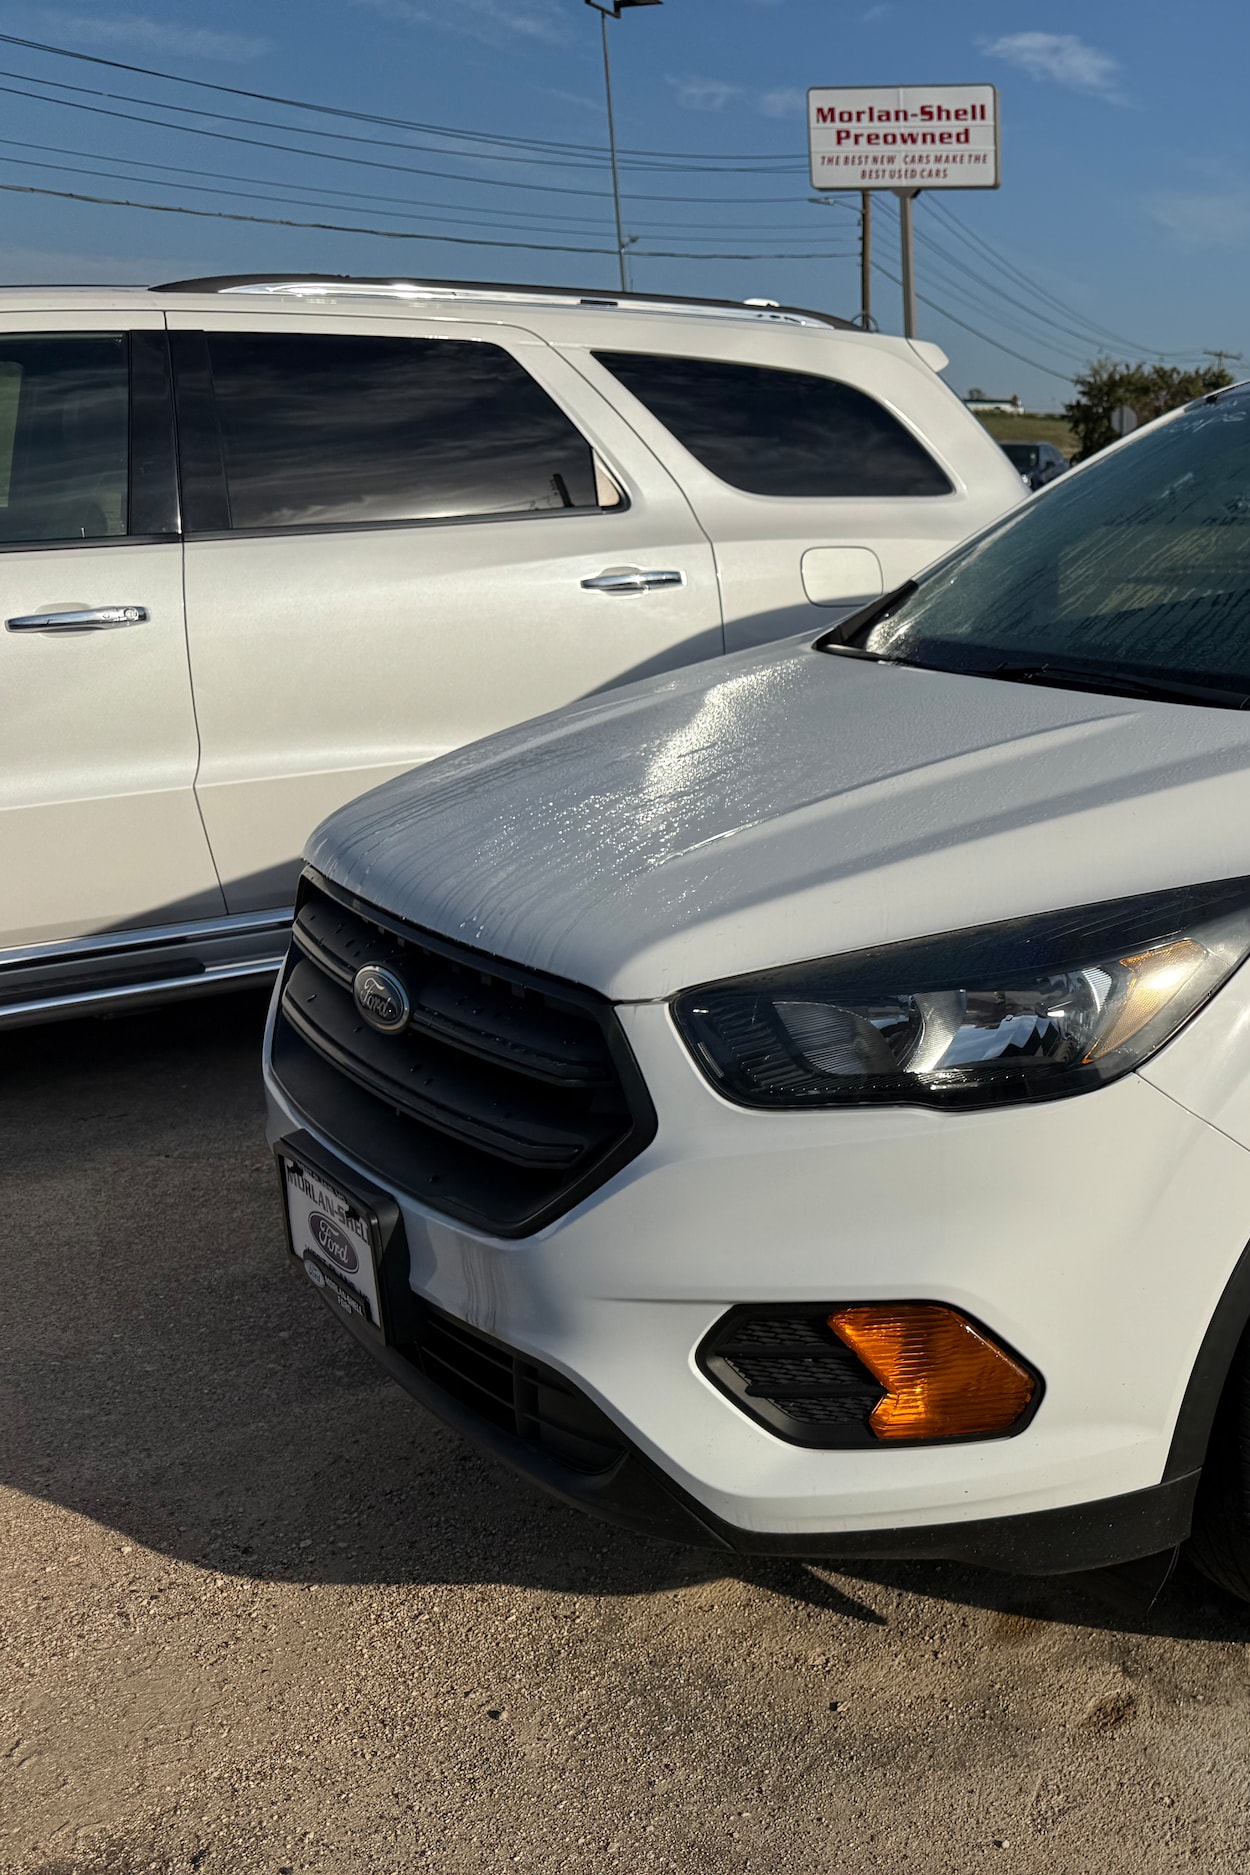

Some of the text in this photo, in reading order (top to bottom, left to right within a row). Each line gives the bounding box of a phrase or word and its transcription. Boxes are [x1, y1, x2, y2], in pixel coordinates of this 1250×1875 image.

[815, 104, 986, 124] Morlan-Shell
[836, 128, 970, 146] Preowned
[820, 153, 988, 166] THE BEST NEW CARS MAKE THE
[860, 168, 948, 180] BEST USED CARS
[361, 977, 392, 1017] Ford
[288, 1172, 368, 1243] MORLAN-SHEL
[319, 1219, 349, 1264] Ford
